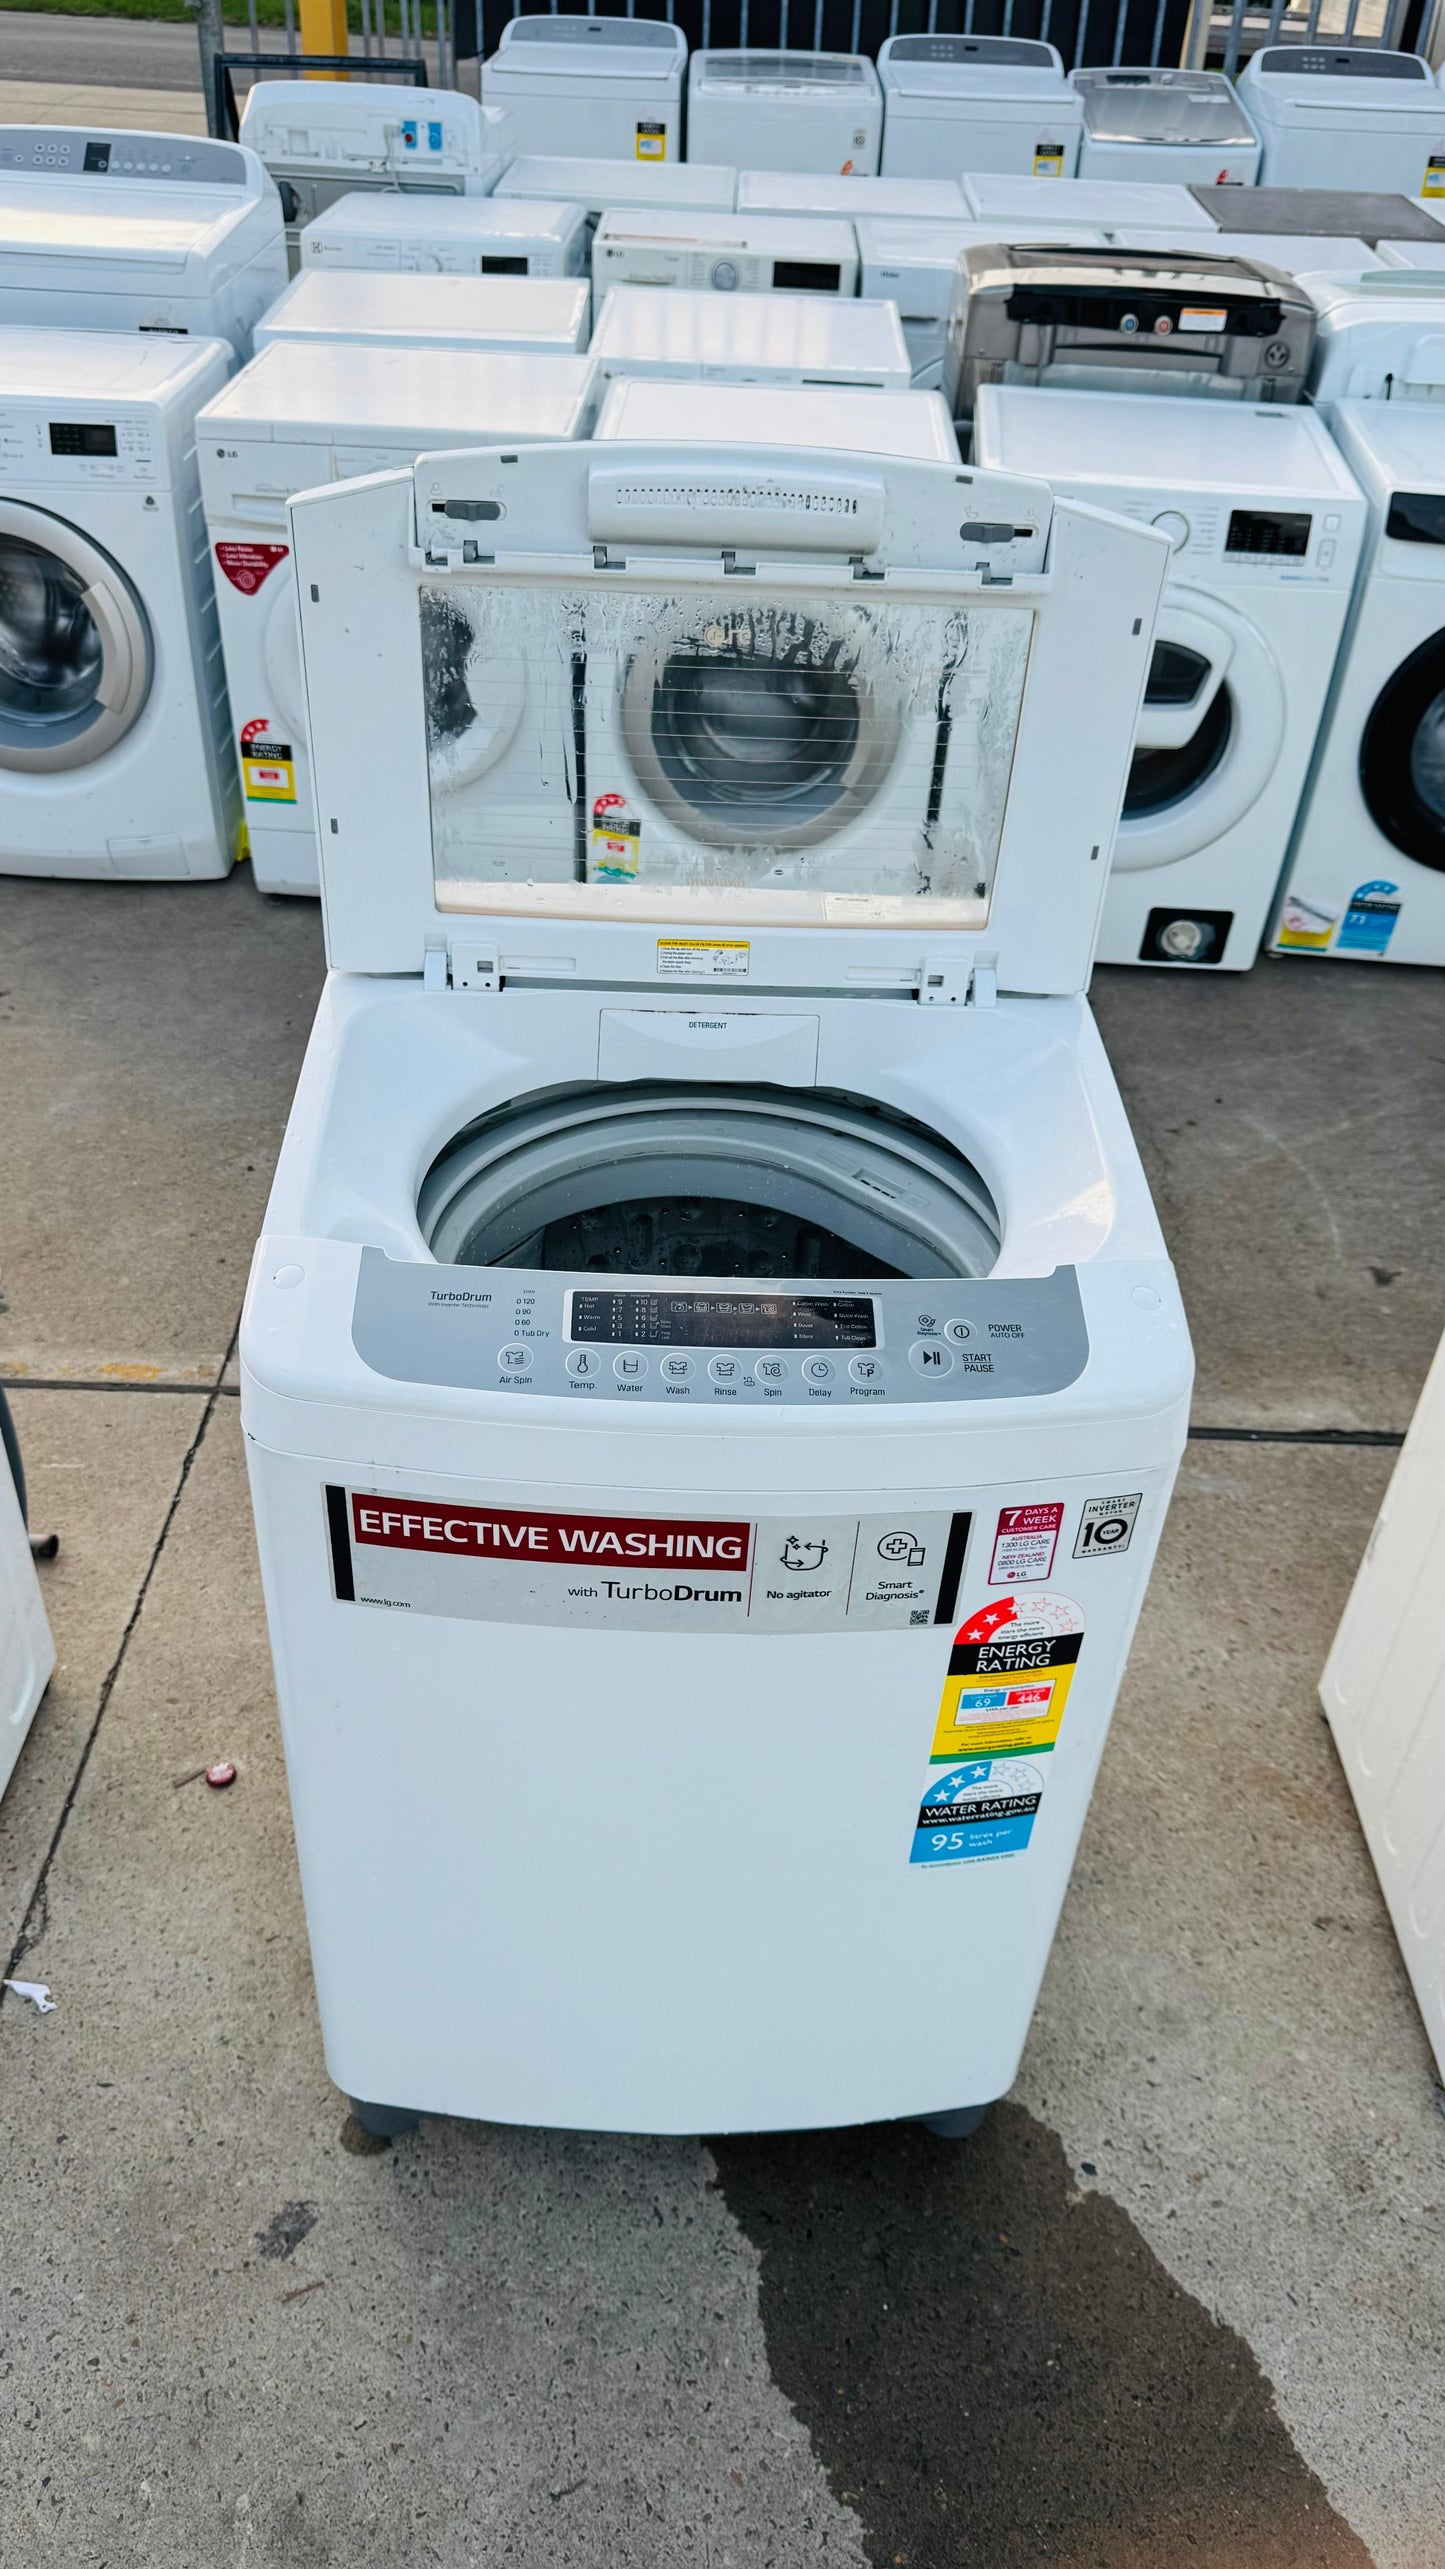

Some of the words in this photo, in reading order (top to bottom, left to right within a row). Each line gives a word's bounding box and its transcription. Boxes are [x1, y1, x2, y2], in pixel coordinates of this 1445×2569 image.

[430, 1291, 492, 1302] TurboDrum
[988, 1324, 1022, 1332] POWER
[962, 1353, 992, 1362] START
[964, 1364, 995, 1373] PAUSE
[499, 1376, 512, 1384] Air
[513, 1376, 532, 1385] Spin
[569, 1381, 598, 1391] Temp.
[617, 1384, 643, 1392] Water
[666, 1386, 690, 1395] Wash
[714, 1387, 737, 1396] Rinse
[763, 1388, 782, 1398] Spin
[808, 1388, 832, 1398] Delay
[850, 1387, 886, 1397] Program
[1025, 1507, 1049, 1516] DAYS
[1088, 1501, 1136, 1513] INVERTER
[1005, 1509, 1023, 1527] 7
[1023, 1515, 1057, 1525] WEEK
[359, 1509, 549, 1550] EFFECTIVE
[557, 1528, 743, 1559] WASHING
[1001, 1525, 1038, 1533] CUSTOMER
[1083, 1518, 1128, 1548] 10
[997, 1559, 1015, 1567] 0800
[1027, 1556, 1047, 1564] CARE
[878, 1581, 913, 1590] Smart
[568, 1586, 598, 1598] with
[600, 1581, 742, 1603] TurboDrum
[767, 1590, 784, 1599] No
[786, 1589, 832, 1601] agitator
[360, 1596, 411, 1609] www.lg.com
[978, 1640, 1057, 1659] ENERGY
[976, 1654, 1051, 1672] RATING
[975, 1698, 991, 1708] 69
[1017, 1693, 1041, 1703] 446
[925, 1804, 977, 1817] WATER
[981, 1795, 1037, 1812] RATING
[922, 1806, 1036, 1825] www.waterrating.gov.au
[969, 1832, 993, 1840] litres
[995, 1829, 1012, 1838] per
[931, 1832, 964, 1852] 95
[969, 1840, 993, 1848] wash
